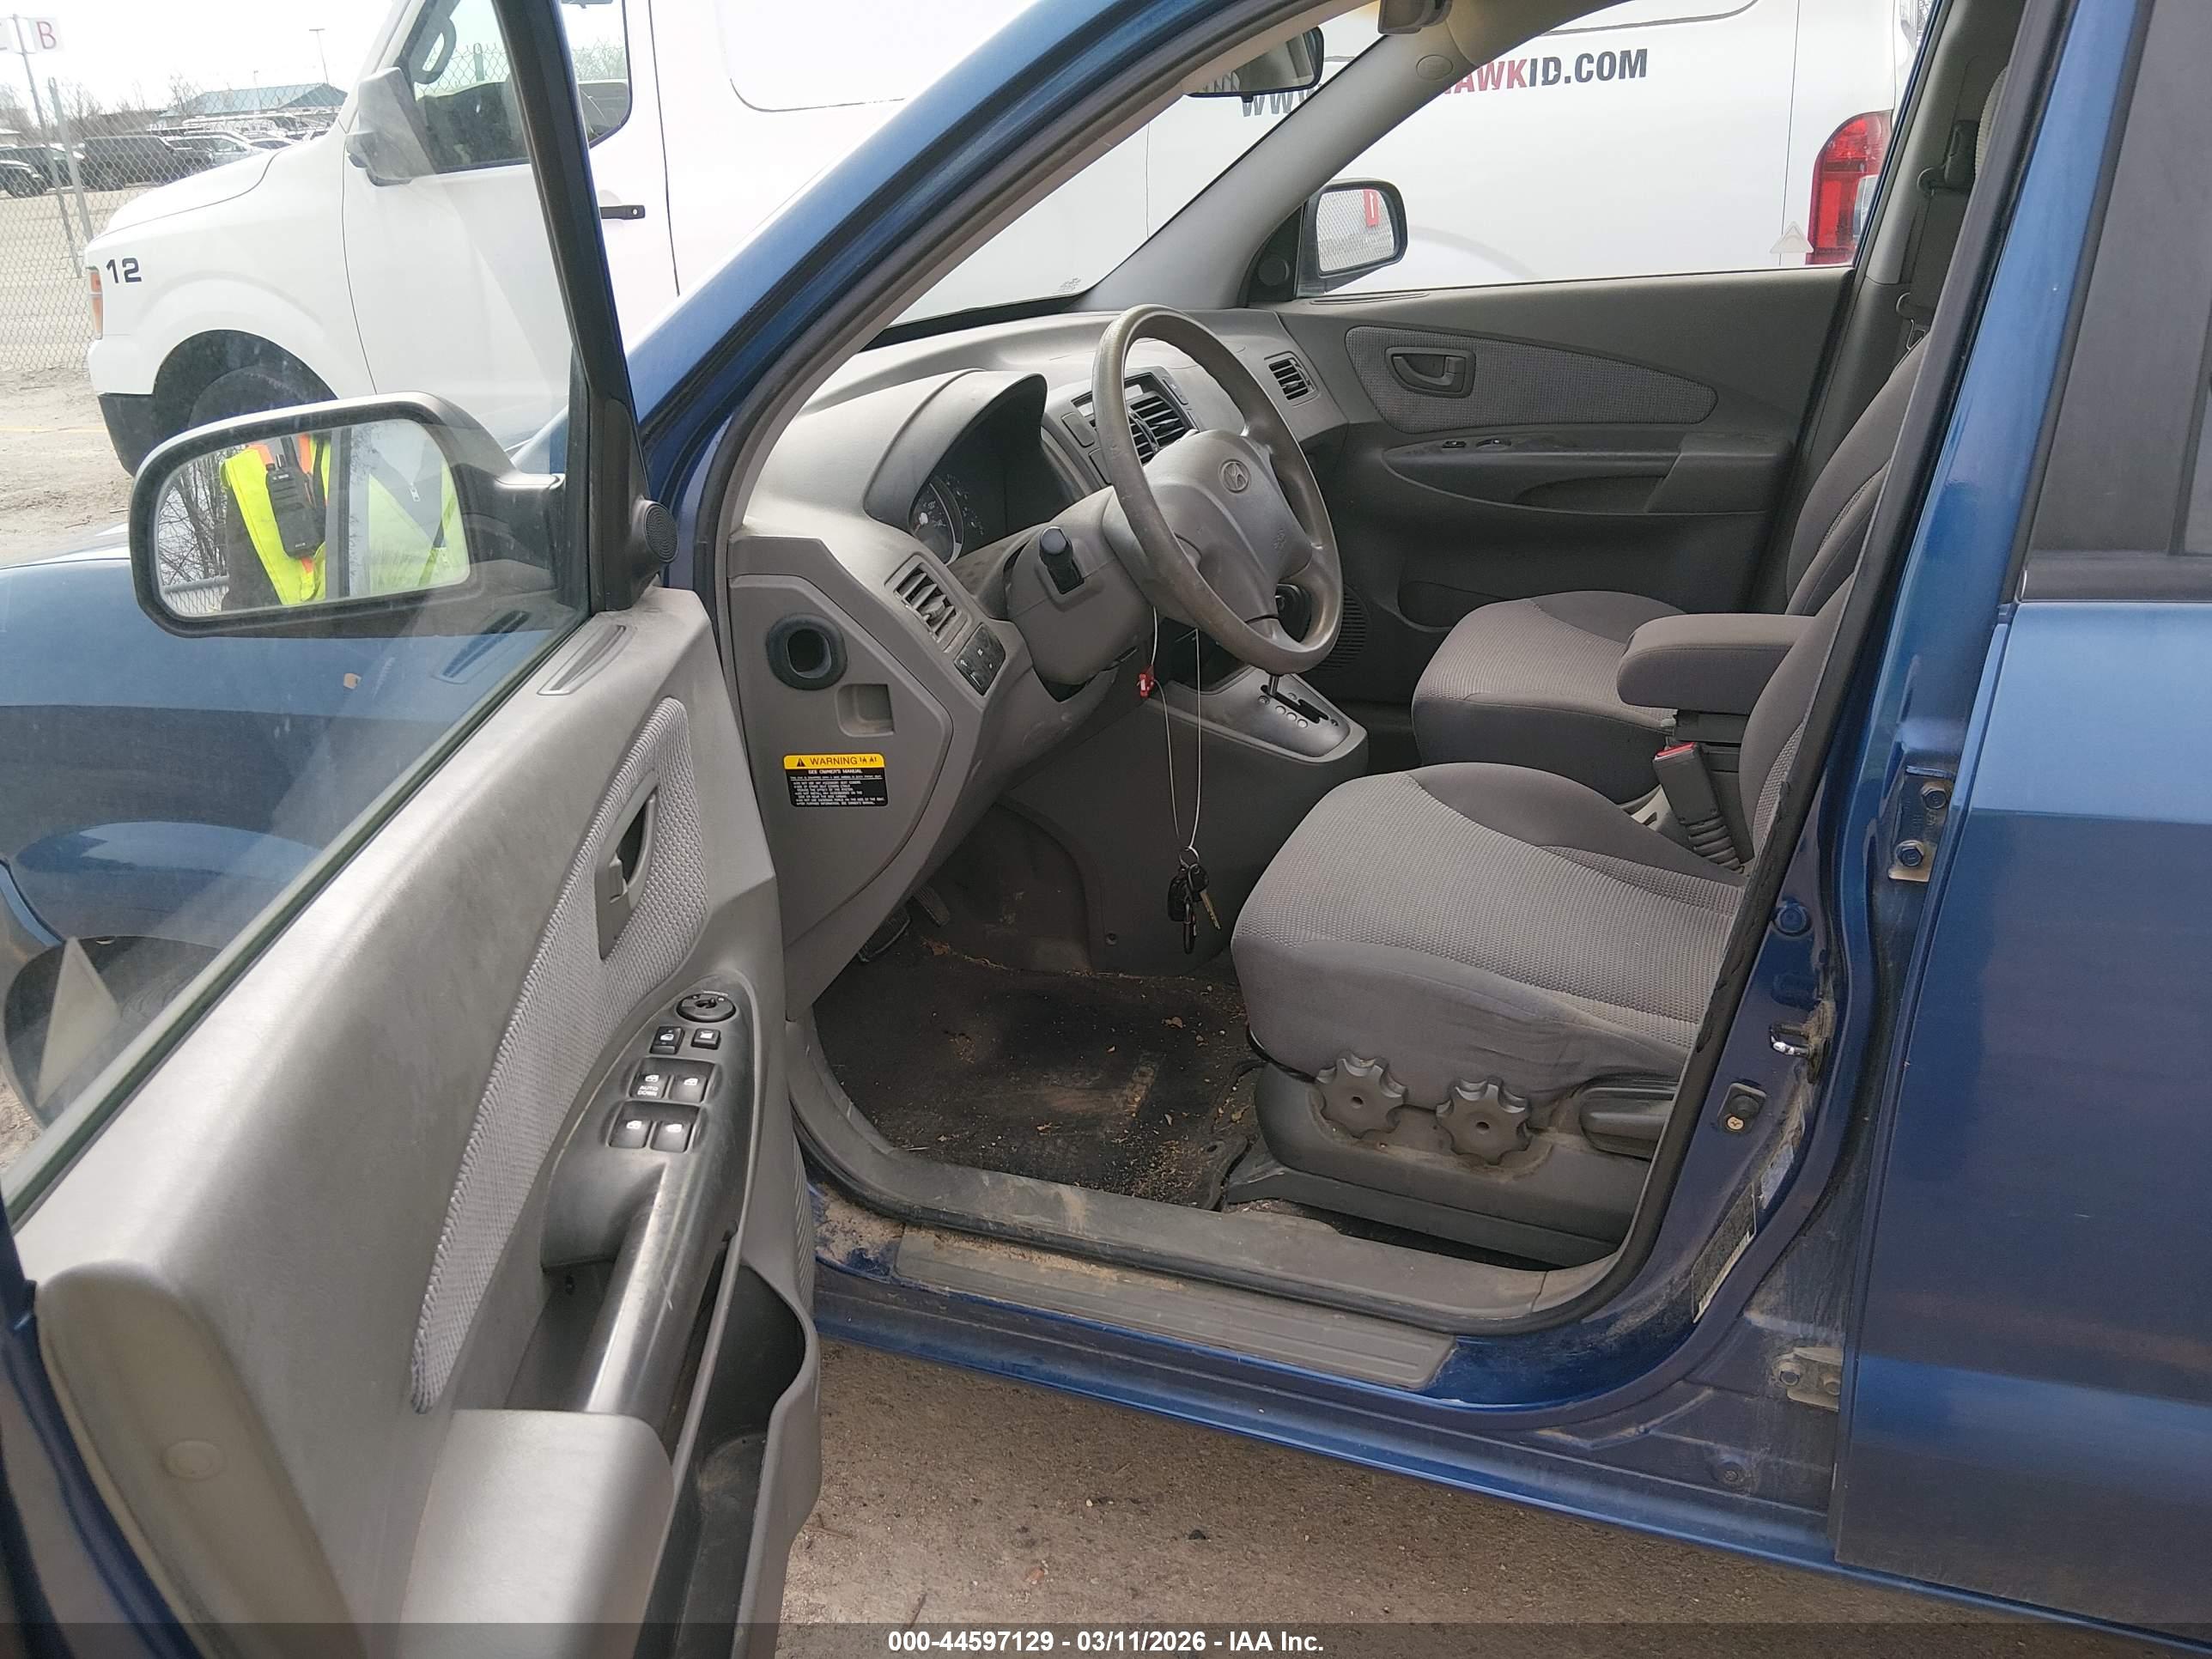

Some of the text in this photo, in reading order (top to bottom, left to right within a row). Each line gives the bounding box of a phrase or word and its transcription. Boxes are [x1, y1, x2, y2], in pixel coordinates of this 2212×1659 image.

[36, 21, 57, 50] B
[1444, 48, 1648, 94] AWKID.COM
[106, 257, 142, 283] 12
[810, 757, 857, 765] WARNING
